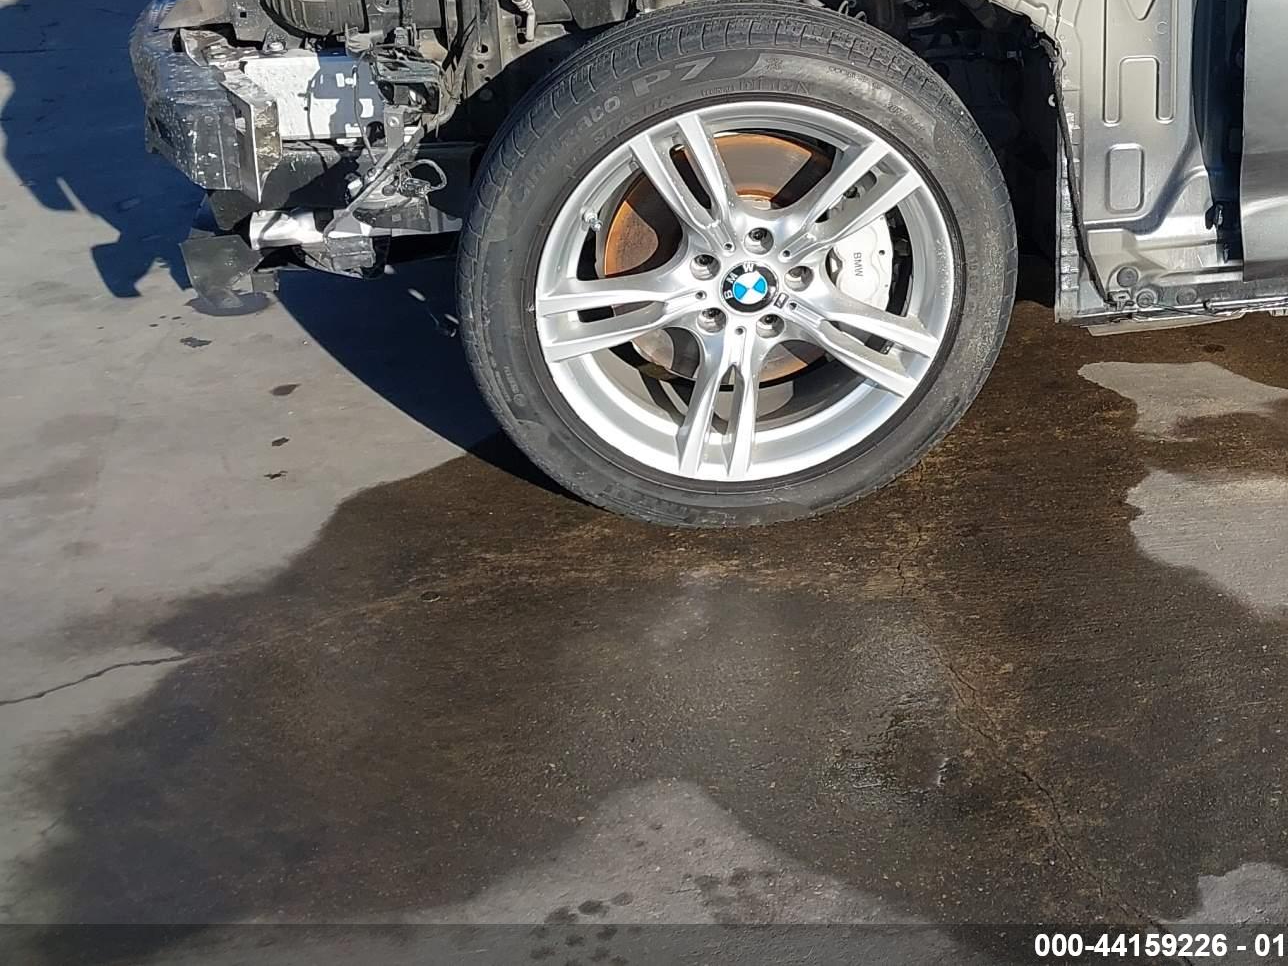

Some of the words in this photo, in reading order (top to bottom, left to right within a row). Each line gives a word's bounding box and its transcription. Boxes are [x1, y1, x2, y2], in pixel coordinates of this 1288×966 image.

[631, 56, 716, 97] P7
[724, 262, 756, 300] BMW
[853, 252, 864, 278] BMW
